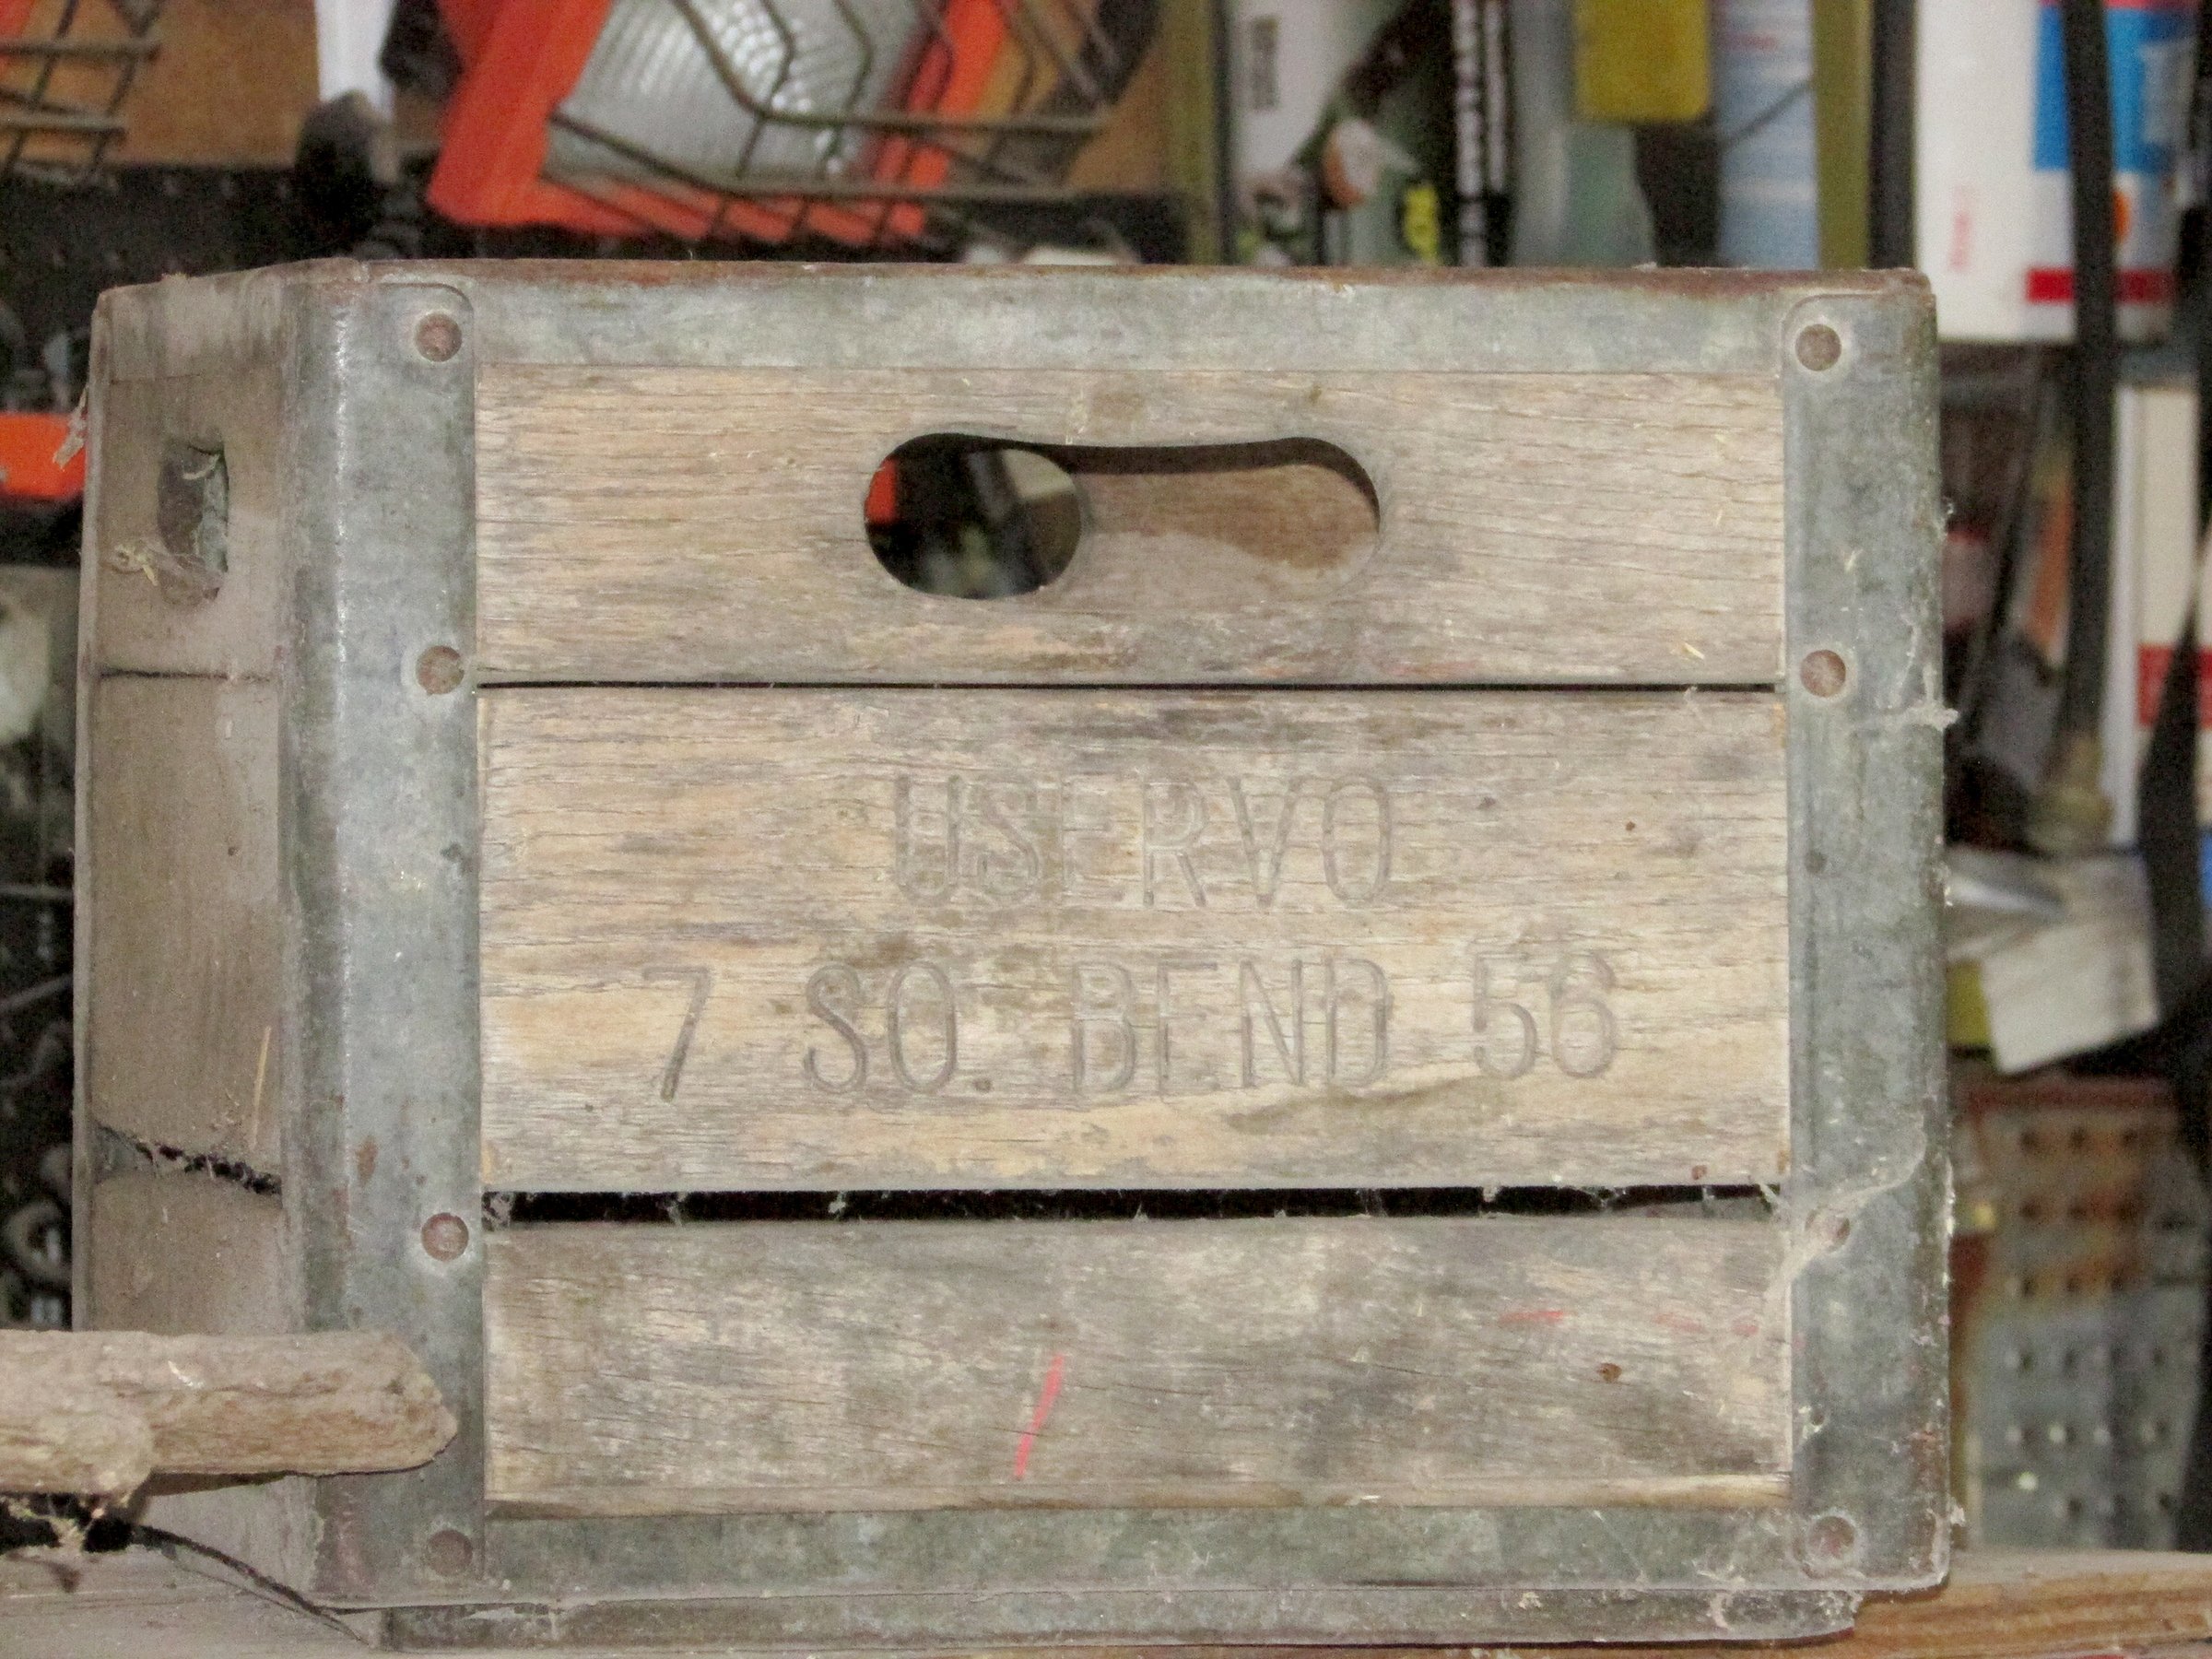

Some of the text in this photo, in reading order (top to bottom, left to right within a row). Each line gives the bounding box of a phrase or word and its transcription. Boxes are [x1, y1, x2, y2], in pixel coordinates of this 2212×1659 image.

[892, 772, 1394, 908] USERVO
[642, 964, 713, 1102] 7
[1069, 958, 1394, 1098] BEND
[1474, 949, 1618, 1079] 56
